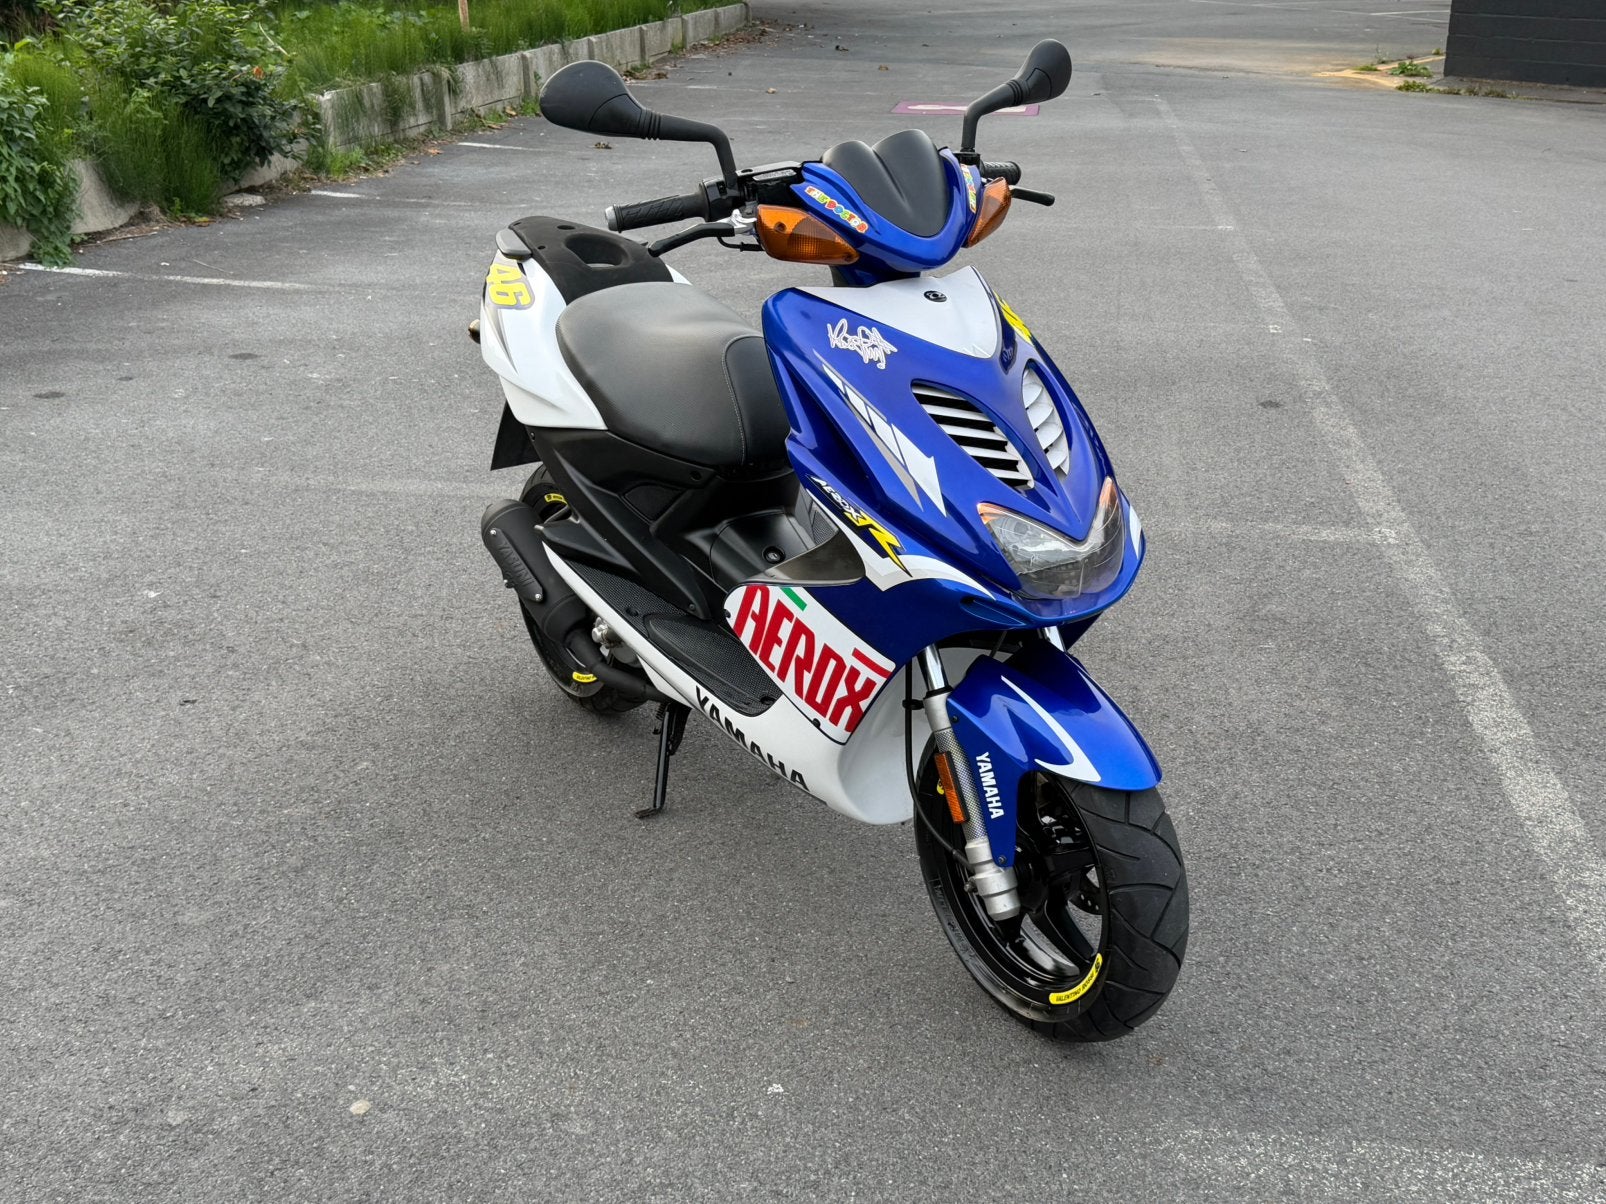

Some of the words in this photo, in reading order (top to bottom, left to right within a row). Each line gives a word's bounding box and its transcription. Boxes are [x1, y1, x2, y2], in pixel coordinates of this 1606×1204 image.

[825, 198, 869, 234] DOCTOR
[486, 263, 532, 307] 46
[732, 584, 877, 734] AEROX
[695, 684, 811, 792] YAMAHA
[975, 751, 1005, 821] YAMAHA
